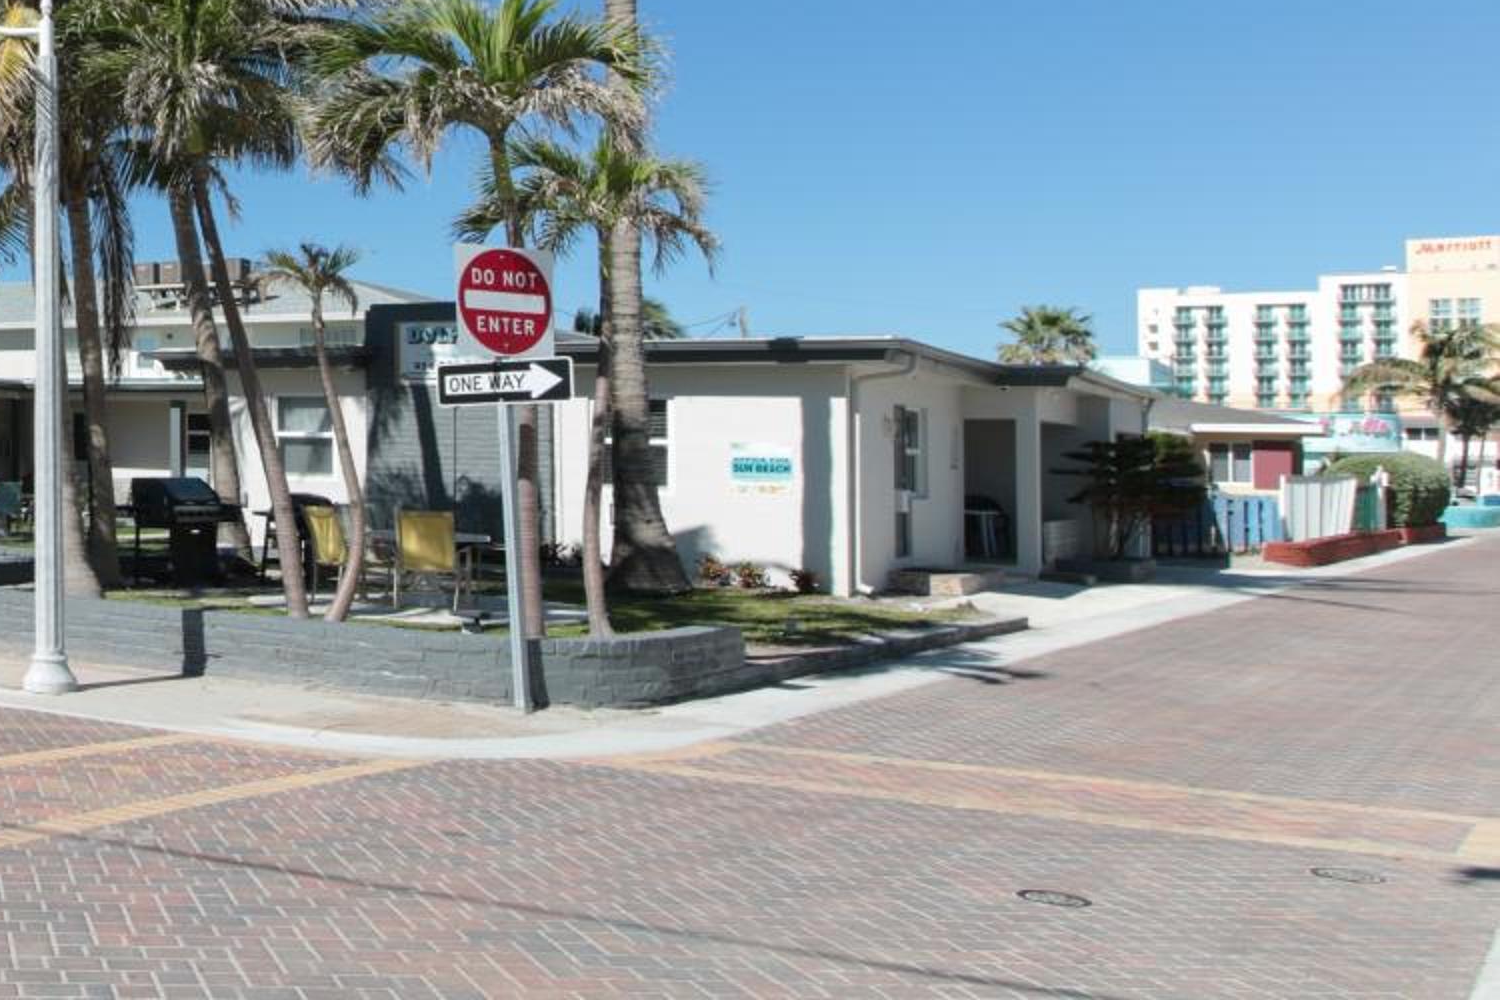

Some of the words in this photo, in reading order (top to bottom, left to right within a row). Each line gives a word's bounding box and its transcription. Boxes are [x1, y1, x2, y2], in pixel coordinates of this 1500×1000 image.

[471, 267, 495, 285] DO
[503, 270, 538, 288] NOT
[476, 315, 536, 336] ENTER
[450, 376, 483, 392] ONE
[488, 374, 525, 390] WAY
